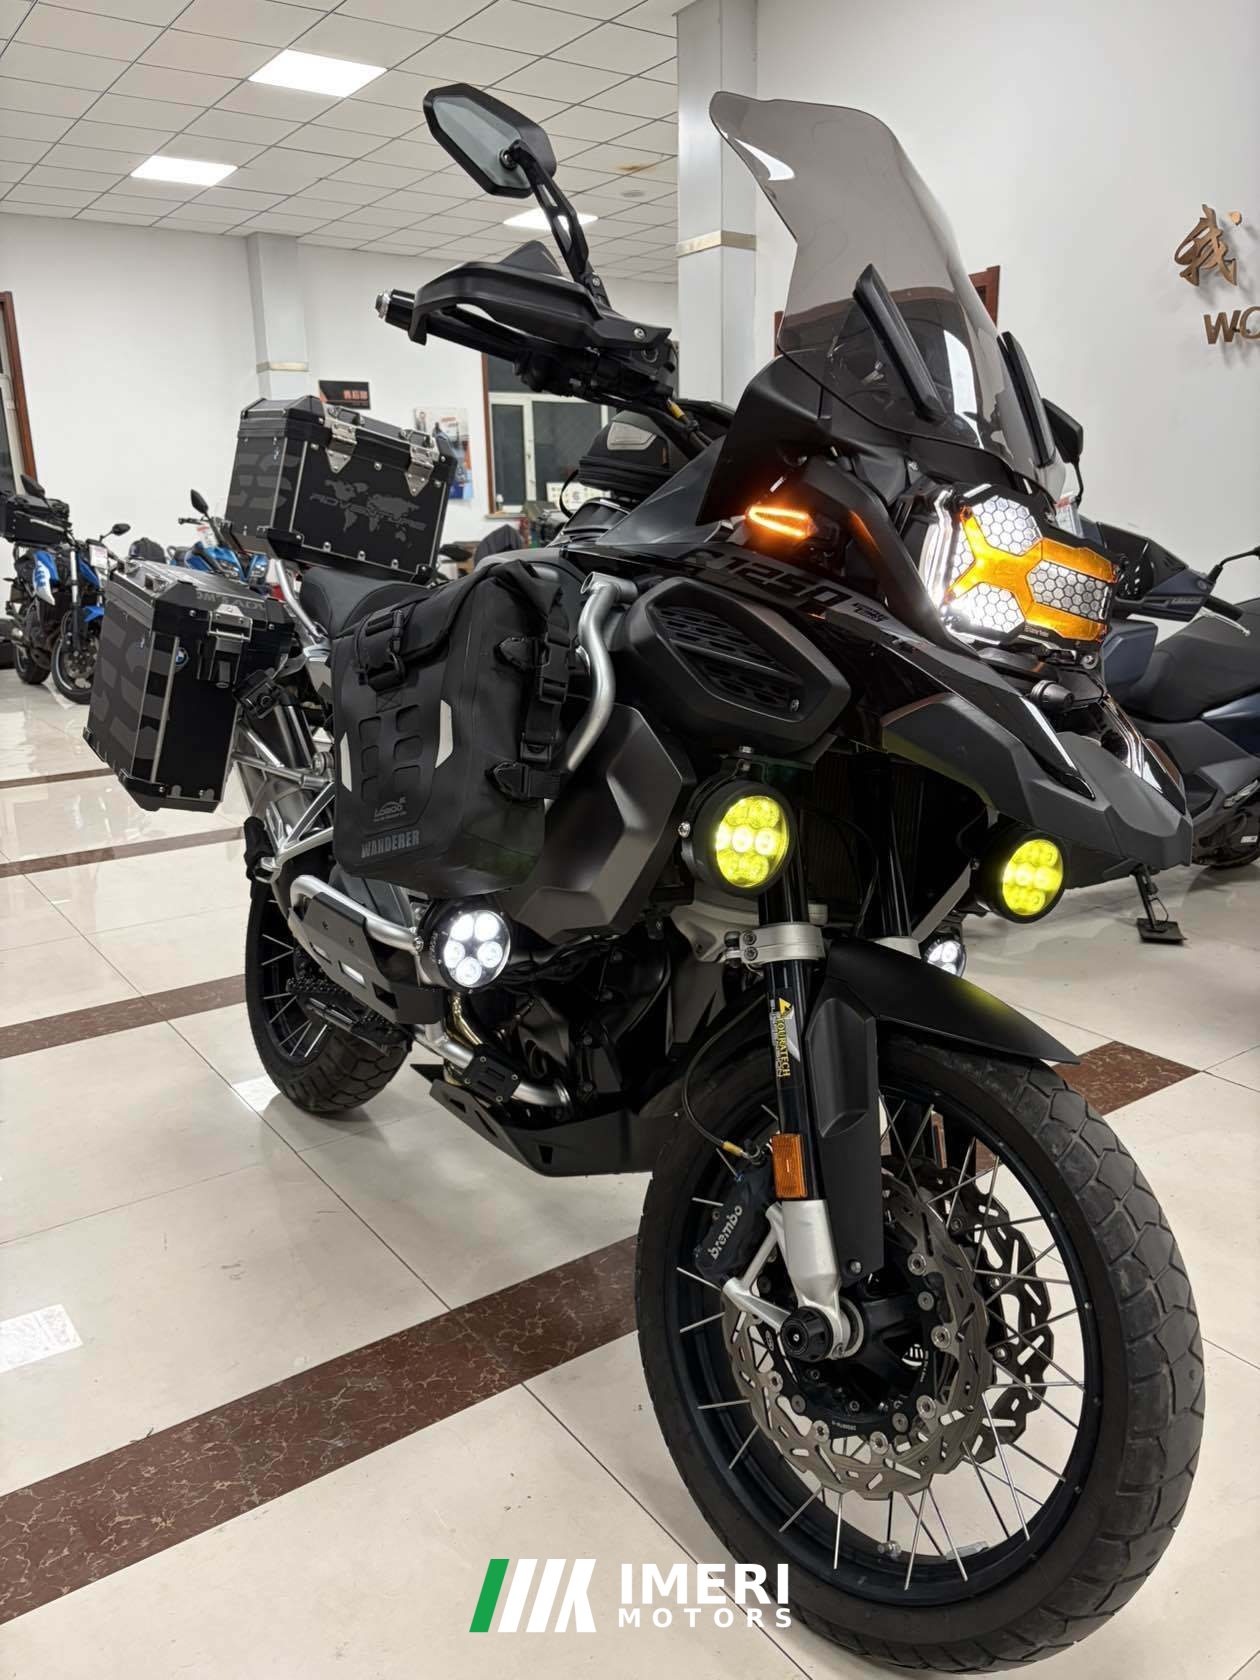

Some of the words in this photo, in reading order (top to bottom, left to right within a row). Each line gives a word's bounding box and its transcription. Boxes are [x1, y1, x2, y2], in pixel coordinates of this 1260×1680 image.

[361, 830, 419, 858] WANDERER
[777, 1015, 791, 1077] TOURATECH
[707, 1204, 743, 1260] brembo
